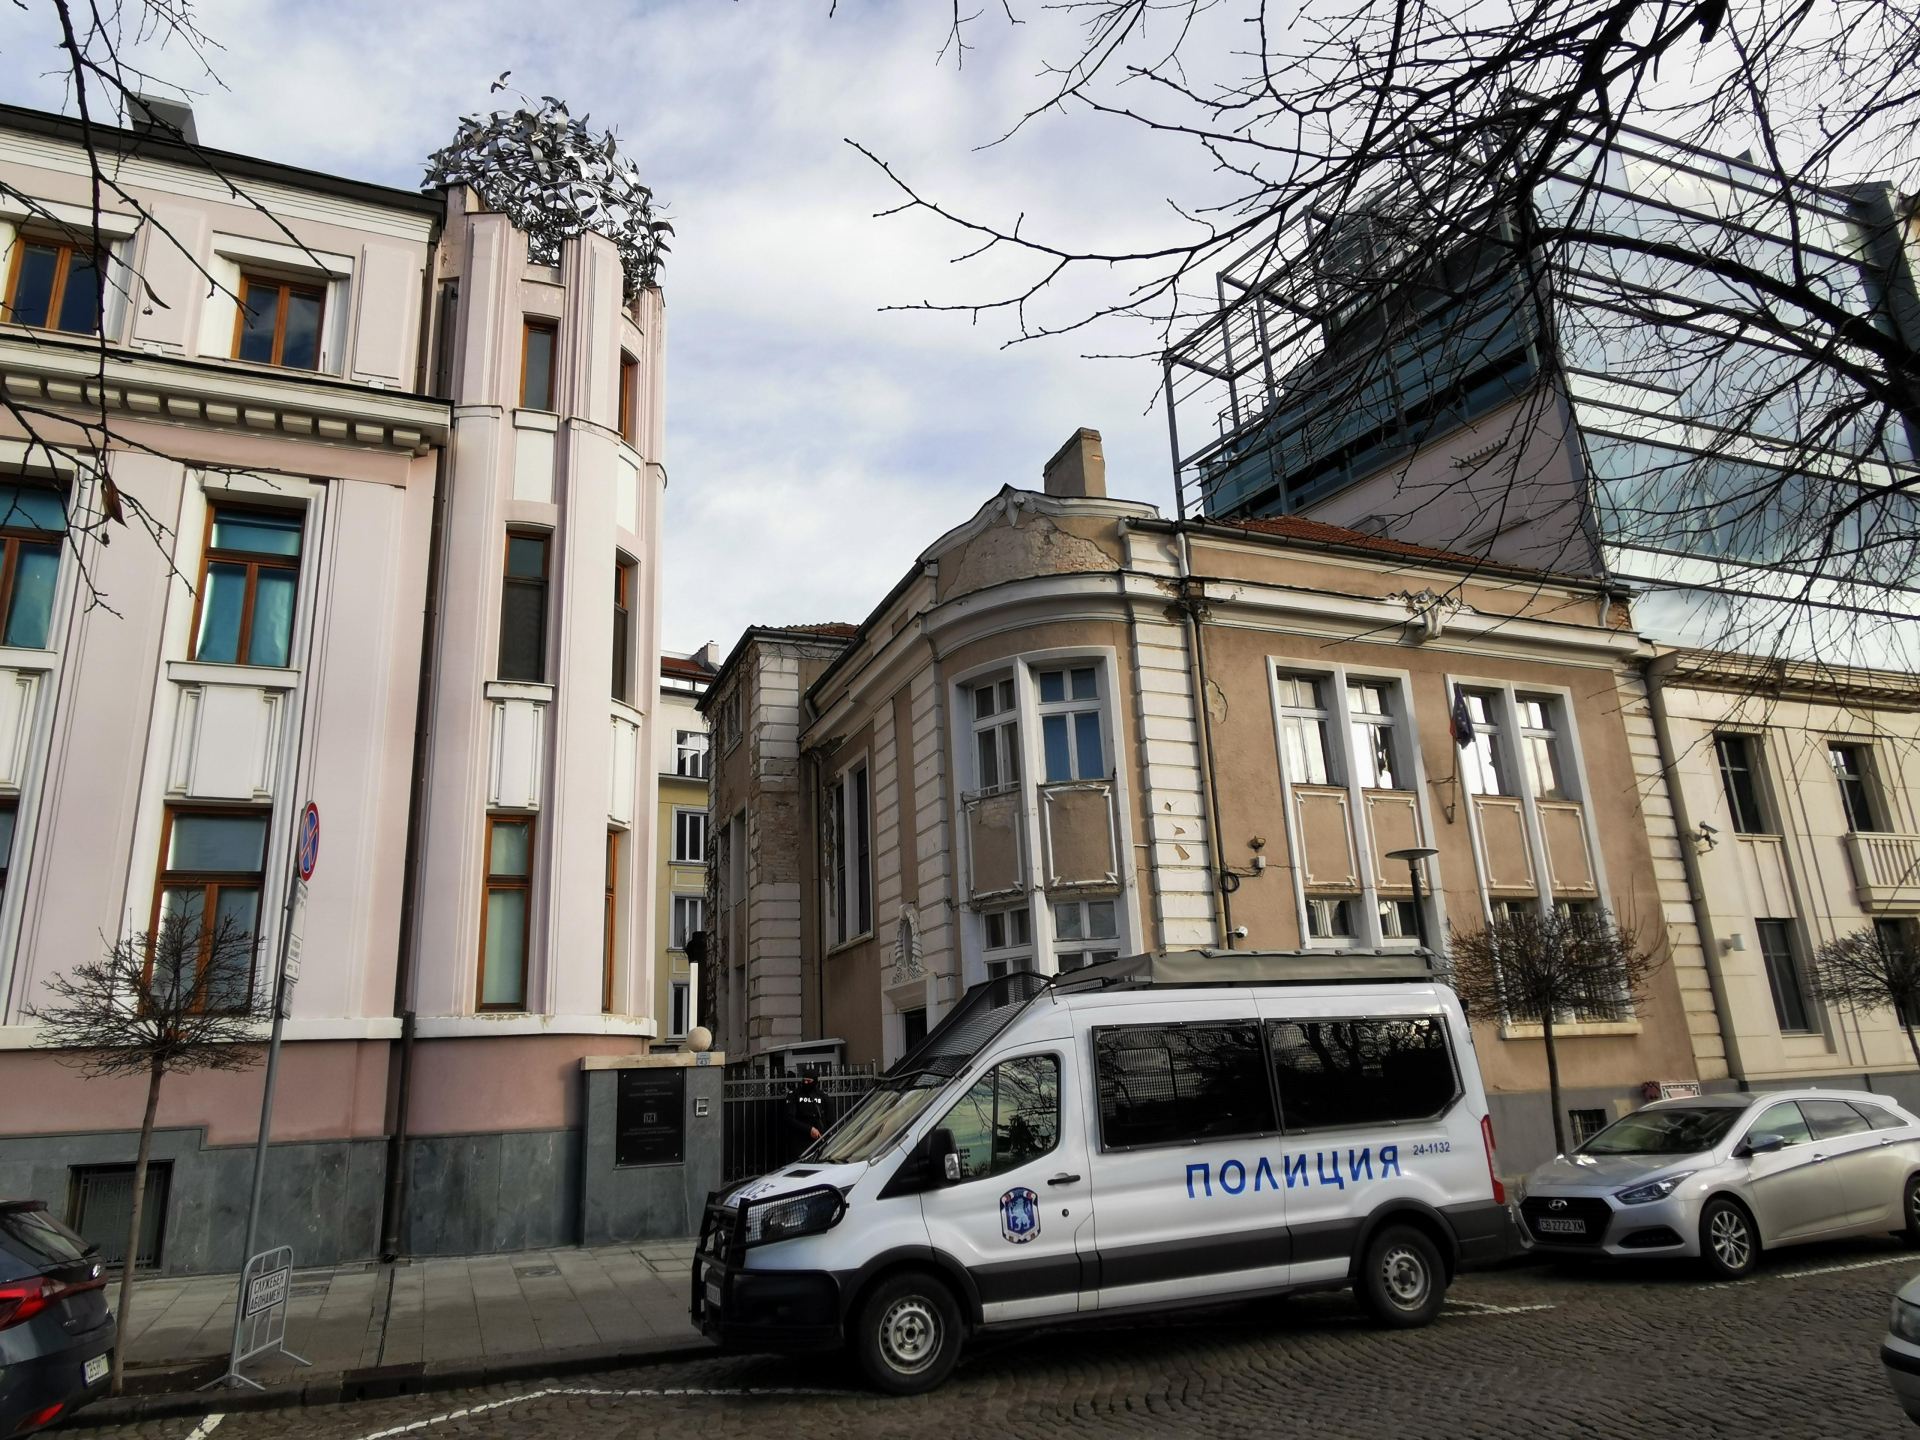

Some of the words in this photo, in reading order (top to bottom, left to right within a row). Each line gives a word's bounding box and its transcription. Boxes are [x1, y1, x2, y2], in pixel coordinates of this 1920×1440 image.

[1412, 1141, 1451, 1156] 24-1132
[1186, 1145, 1402, 1199] ПОЛИЦИЯ
[254, 1270, 286, 1295] СЛУЖЕБЕН
[249, 1285, 285, 1311] АБОНАМЕНТ
